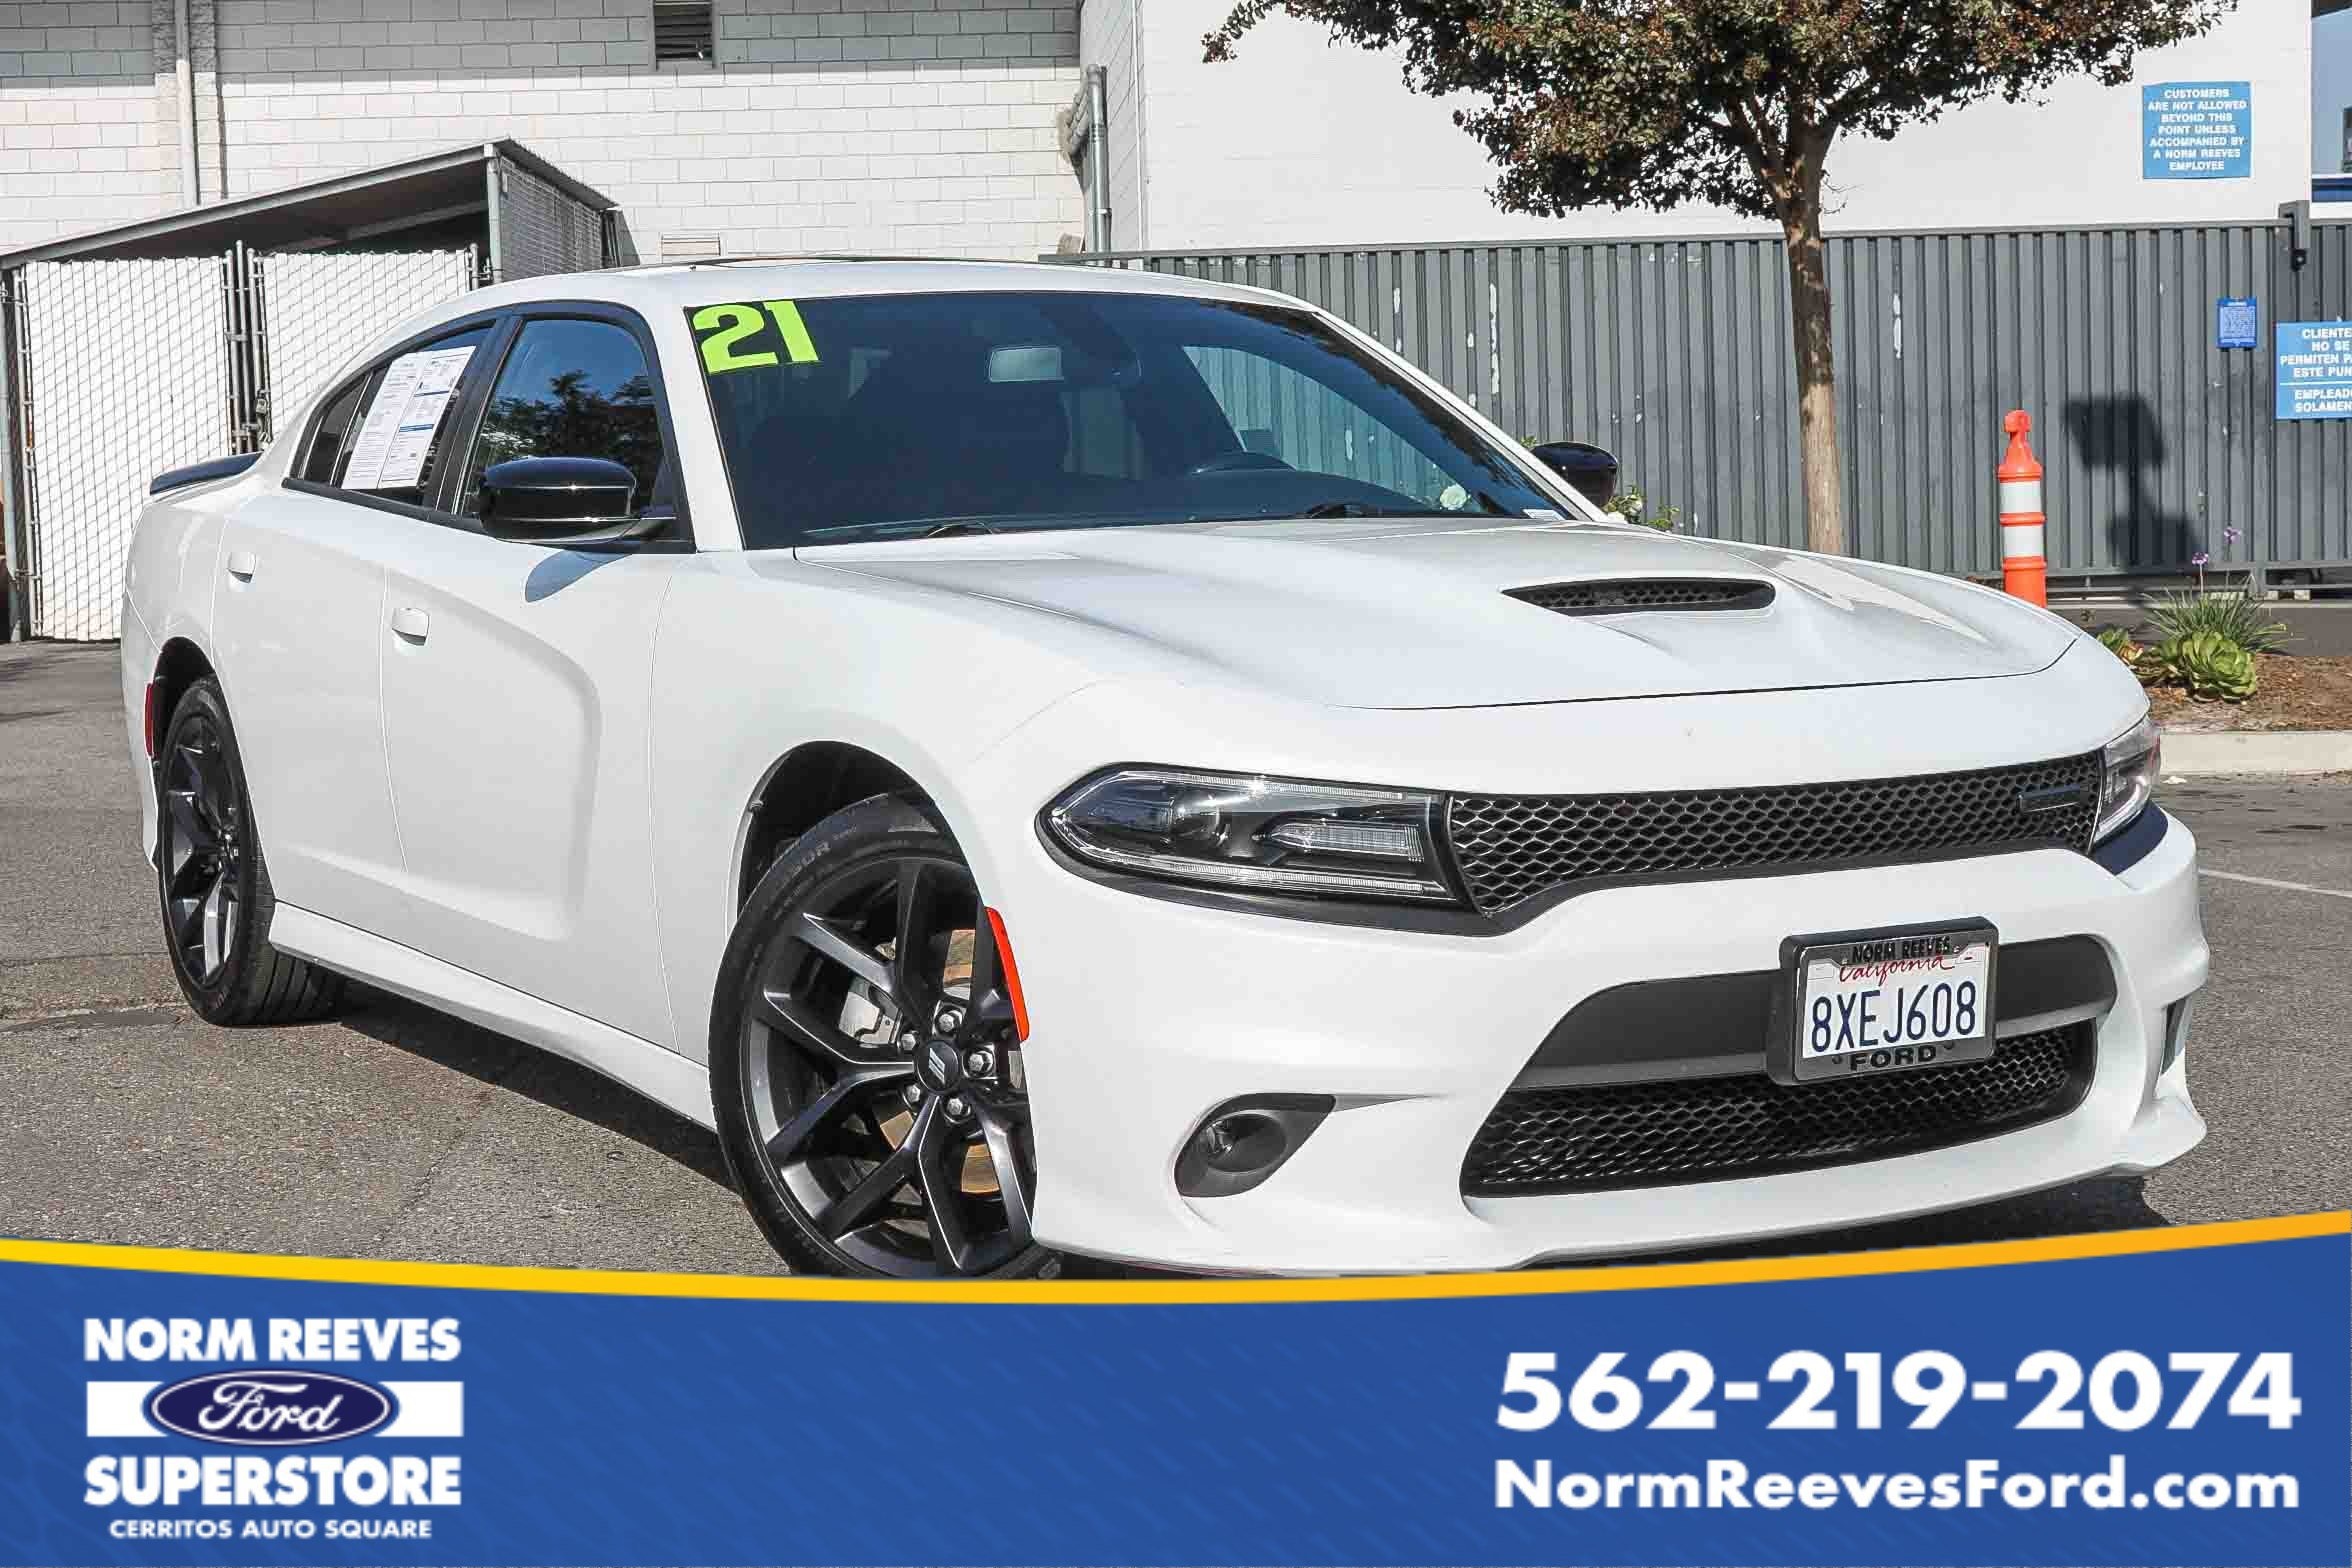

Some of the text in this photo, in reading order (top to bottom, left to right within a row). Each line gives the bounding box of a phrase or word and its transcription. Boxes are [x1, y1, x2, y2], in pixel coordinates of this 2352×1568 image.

[2164, 88, 2230, 98] CUSTOMERS
[2148, 100, 2247, 111] ARE NOT ALLOWED
[2161, 112, 2232, 123] BEYOND THIS
[2158, 124, 2236, 135] POINT UNLESS
[2150, 136, 2245, 147] ACCOMPANIED BY
[2153, 148, 2241, 159] A NORM REEVES
[2169, 160, 2225, 170] EMPLOYEE
[692, 300, 819, 375] 21
[2311, 341, 2350, 352] NO SE
[2280, 354, 2339, 366] PERMITEN
[2293, 367, 2323, 378] ESTE
[2294, 388, 2352, 400] EMPLEAD
[1852, 936, 1951, 963] NORM REEVES
[1839, 956, 1956, 986] California
[1811, 981, 1976, 1053] 8XEJ608
[1850, 1045, 1936, 1070] FORD
